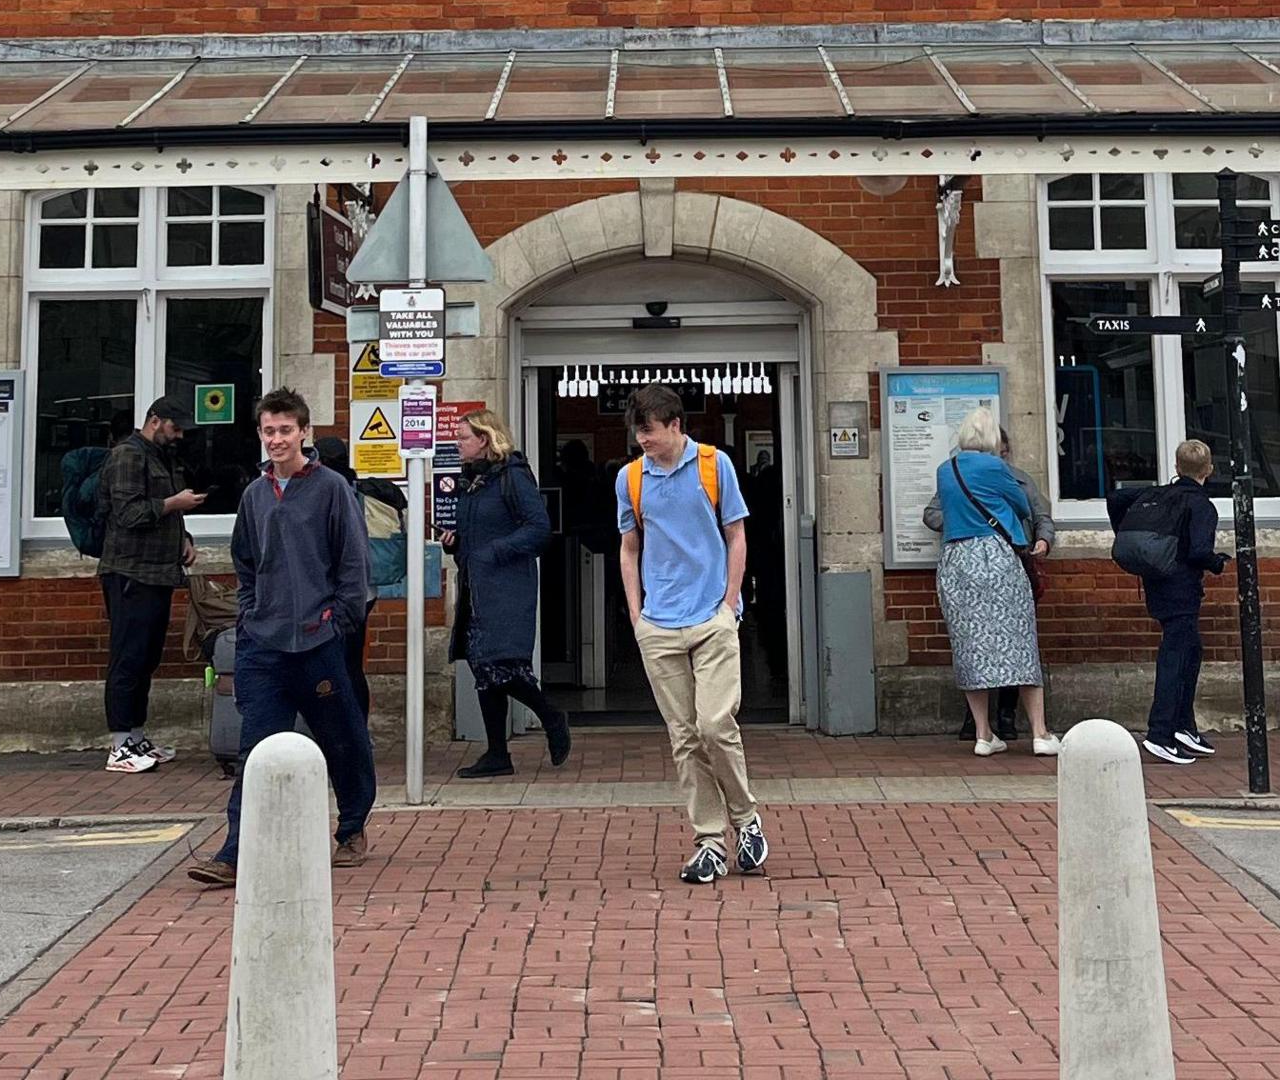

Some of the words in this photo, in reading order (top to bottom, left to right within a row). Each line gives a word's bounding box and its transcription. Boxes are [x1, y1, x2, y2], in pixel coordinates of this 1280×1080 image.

[386, 321, 438, 329] VALUABLES
[1097, 321, 1130, 330] TAXIS
[421, 350, 436, 358] park
